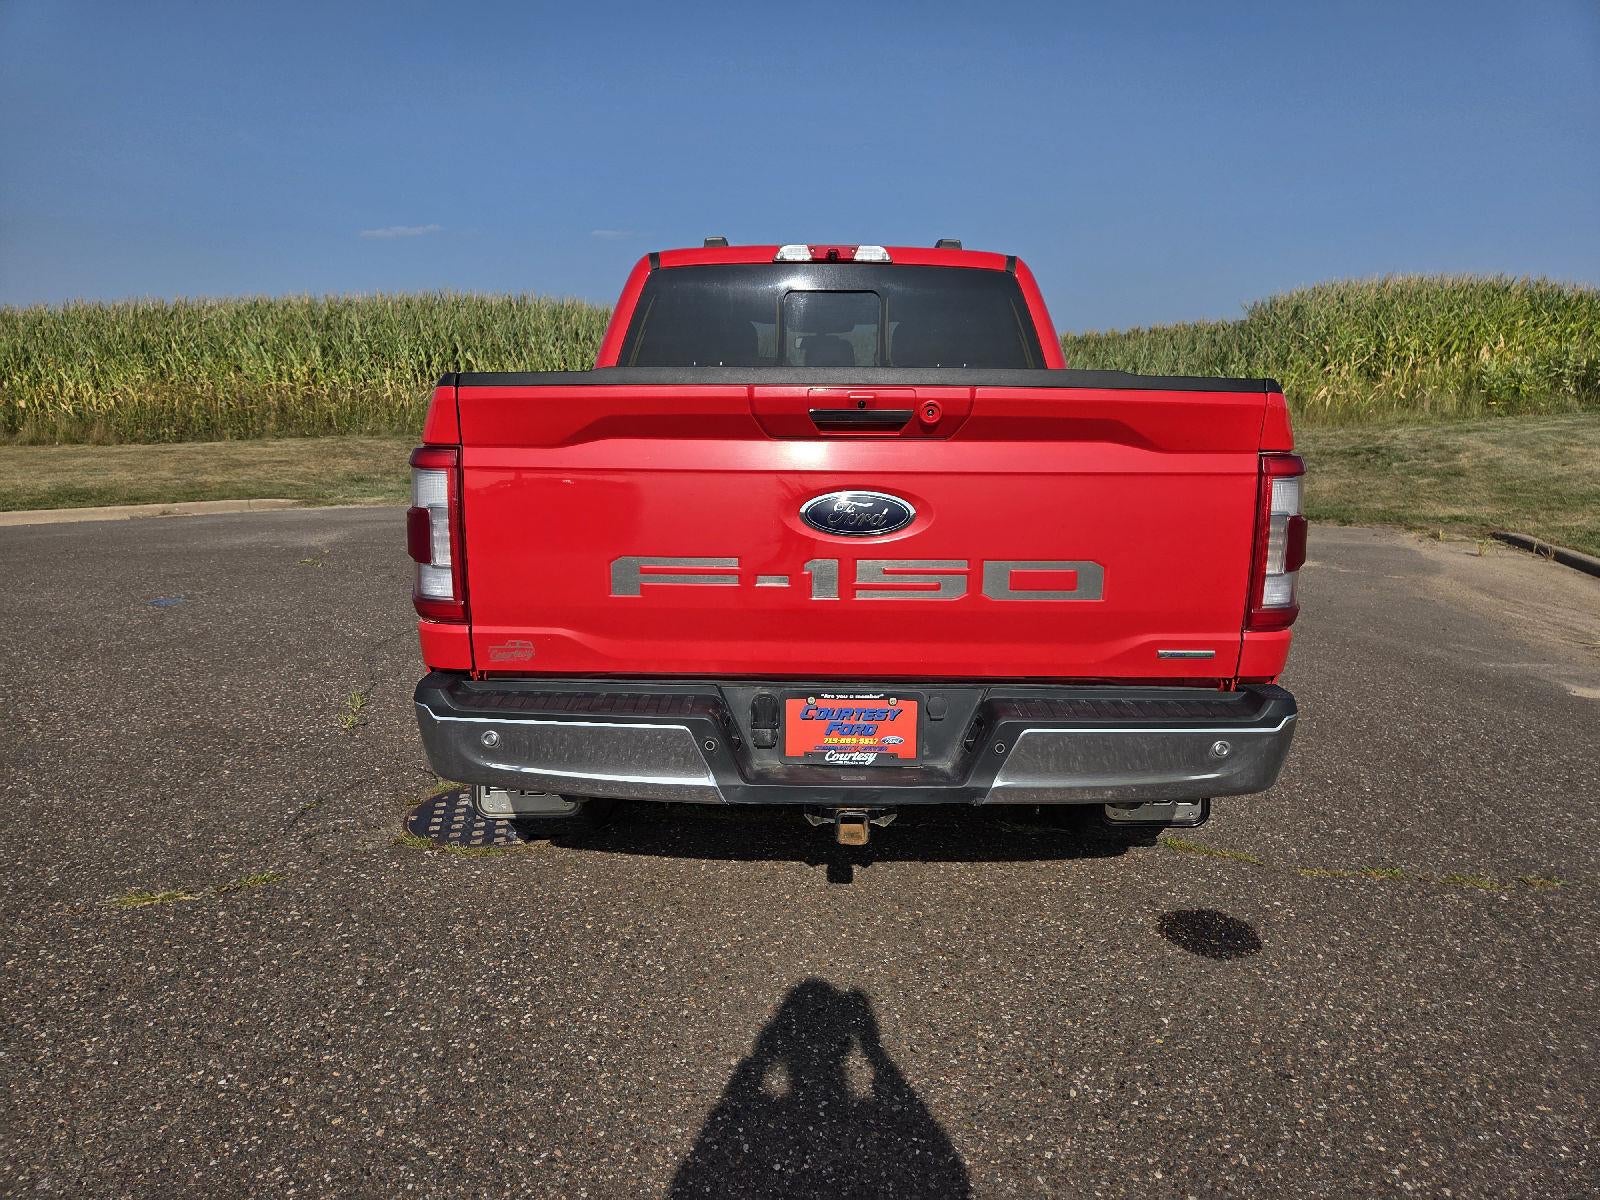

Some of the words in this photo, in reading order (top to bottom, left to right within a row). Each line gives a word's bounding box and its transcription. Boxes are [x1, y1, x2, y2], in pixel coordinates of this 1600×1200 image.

[827, 499, 889, 527] Ford
[609, 556, 1105, 601] F-150
[824, 749, 879, 766] Courtesy
